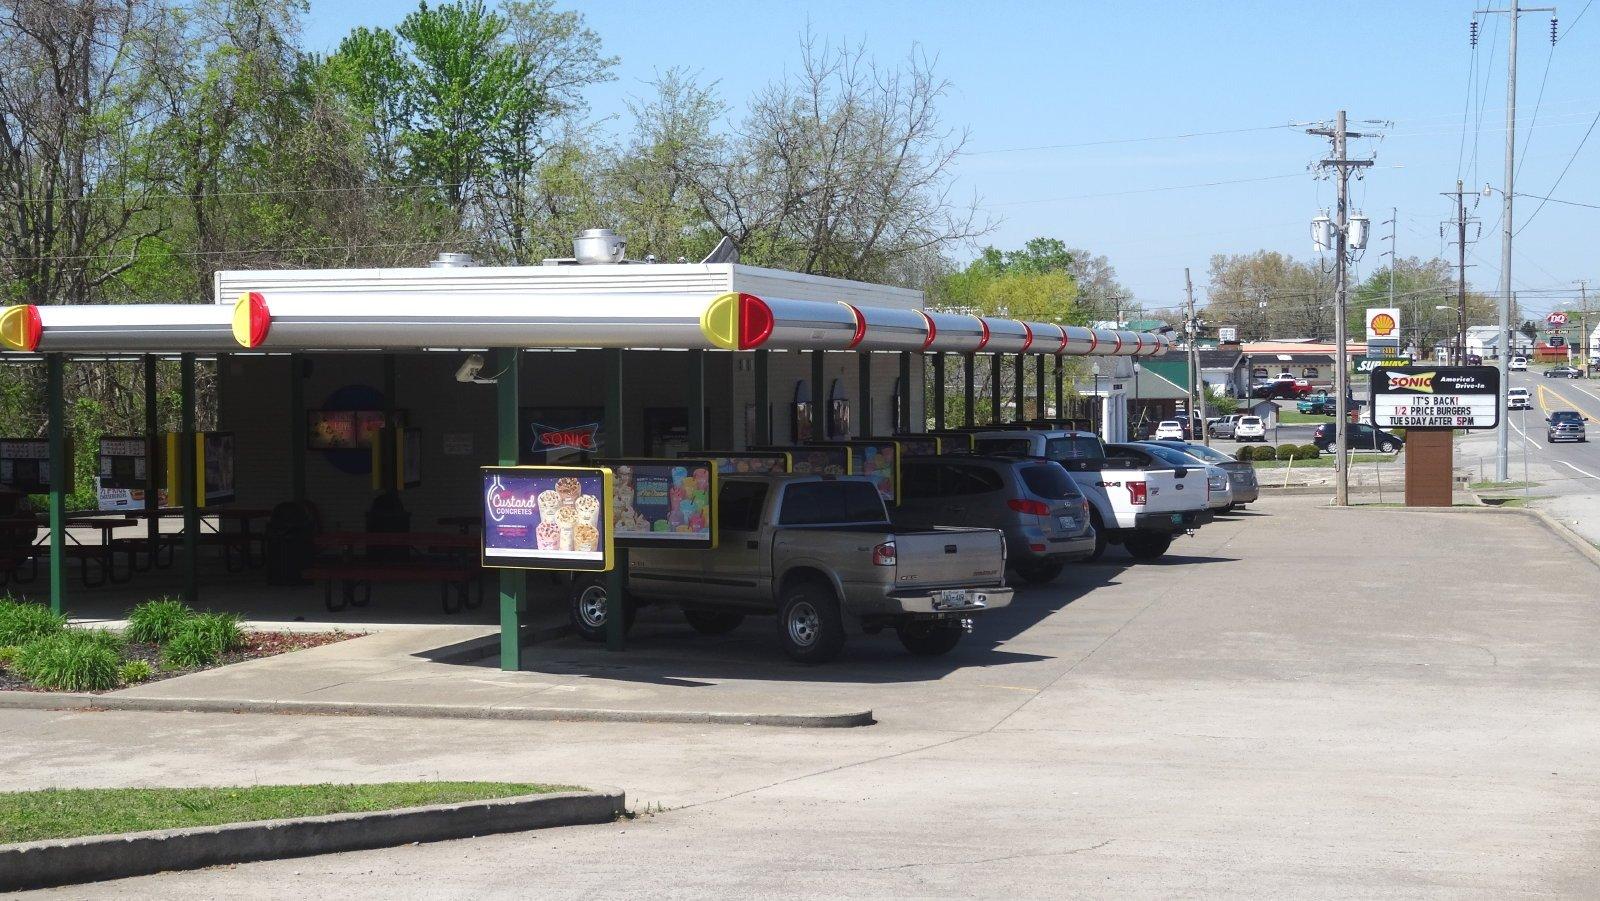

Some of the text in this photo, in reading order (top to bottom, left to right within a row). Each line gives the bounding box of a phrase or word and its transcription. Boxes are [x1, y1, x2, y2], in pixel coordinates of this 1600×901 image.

[1550, 315, 1565, 323] DQ
[1390, 377, 1432, 388] SONIC
[1412, 396, 1459, 405] IT'S BACK!
[1395, 407, 1471, 415] 1/2 PRICE BURGERS
[1428, 417, 1452, 425] AFTER
[1456, 417, 1474, 425] 5PM
[539, 431, 593, 448] SONIC
[493, 494, 536, 508] Custard
